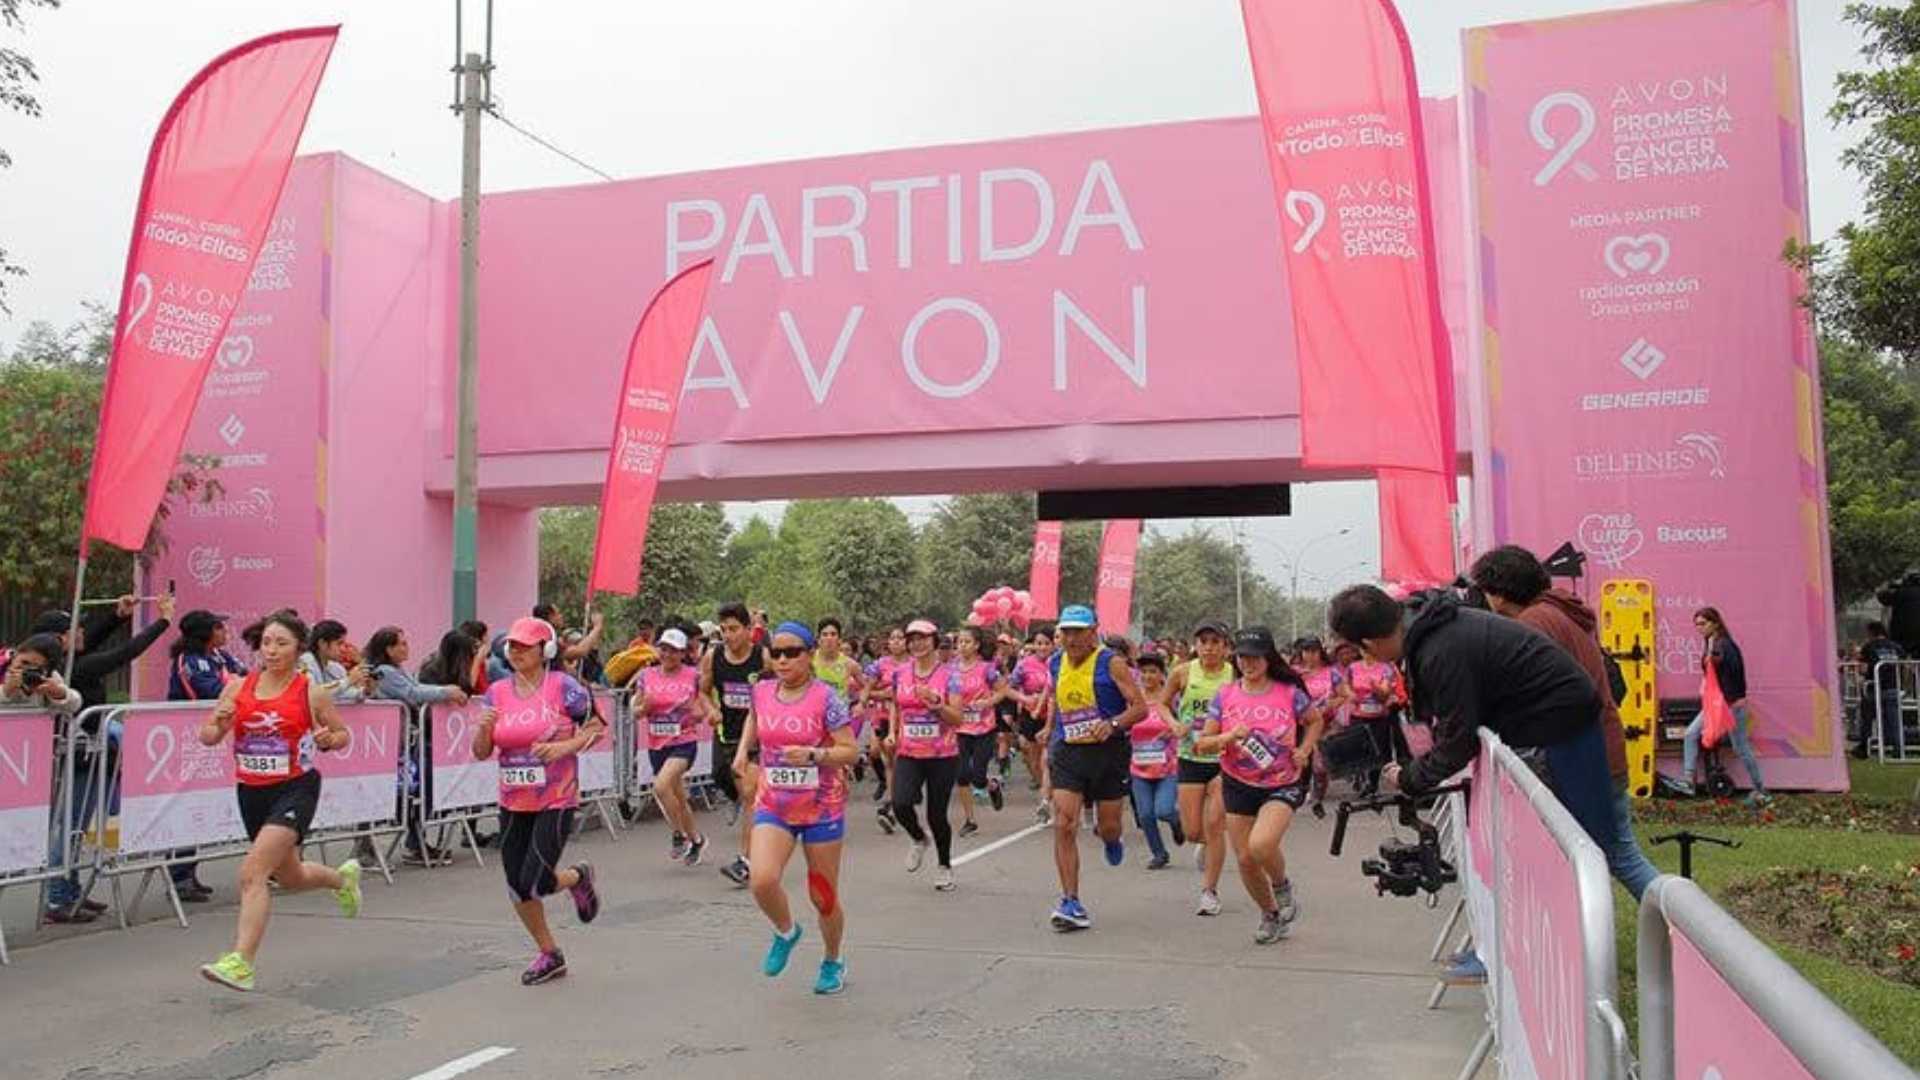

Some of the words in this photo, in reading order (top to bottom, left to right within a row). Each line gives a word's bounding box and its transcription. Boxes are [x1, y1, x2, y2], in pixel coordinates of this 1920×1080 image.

[1611, 75, 1729, 108] AVON
[1613, 104, 1733, 132] PROMESA
[1615, 161, 1648, 180] DE
[1336, 178, 1414, 202] AVON
[665, 160, 1144, 283] PARTIDA
[1570, 212, 1622, 227] MEDIA
[1624, 205, 1701, 223] PARTNER
[160, 281, 238, 311] AVON
[156, 302, 222, 329] PROMES
[681, 286, 1148, 408] AVON
[1575, 450, 1696, 475] DELFINES
[501, 700, 560, 727] VON
[505, 768, 537, 783] 2716
[771, 768, 808, 784] 2917
